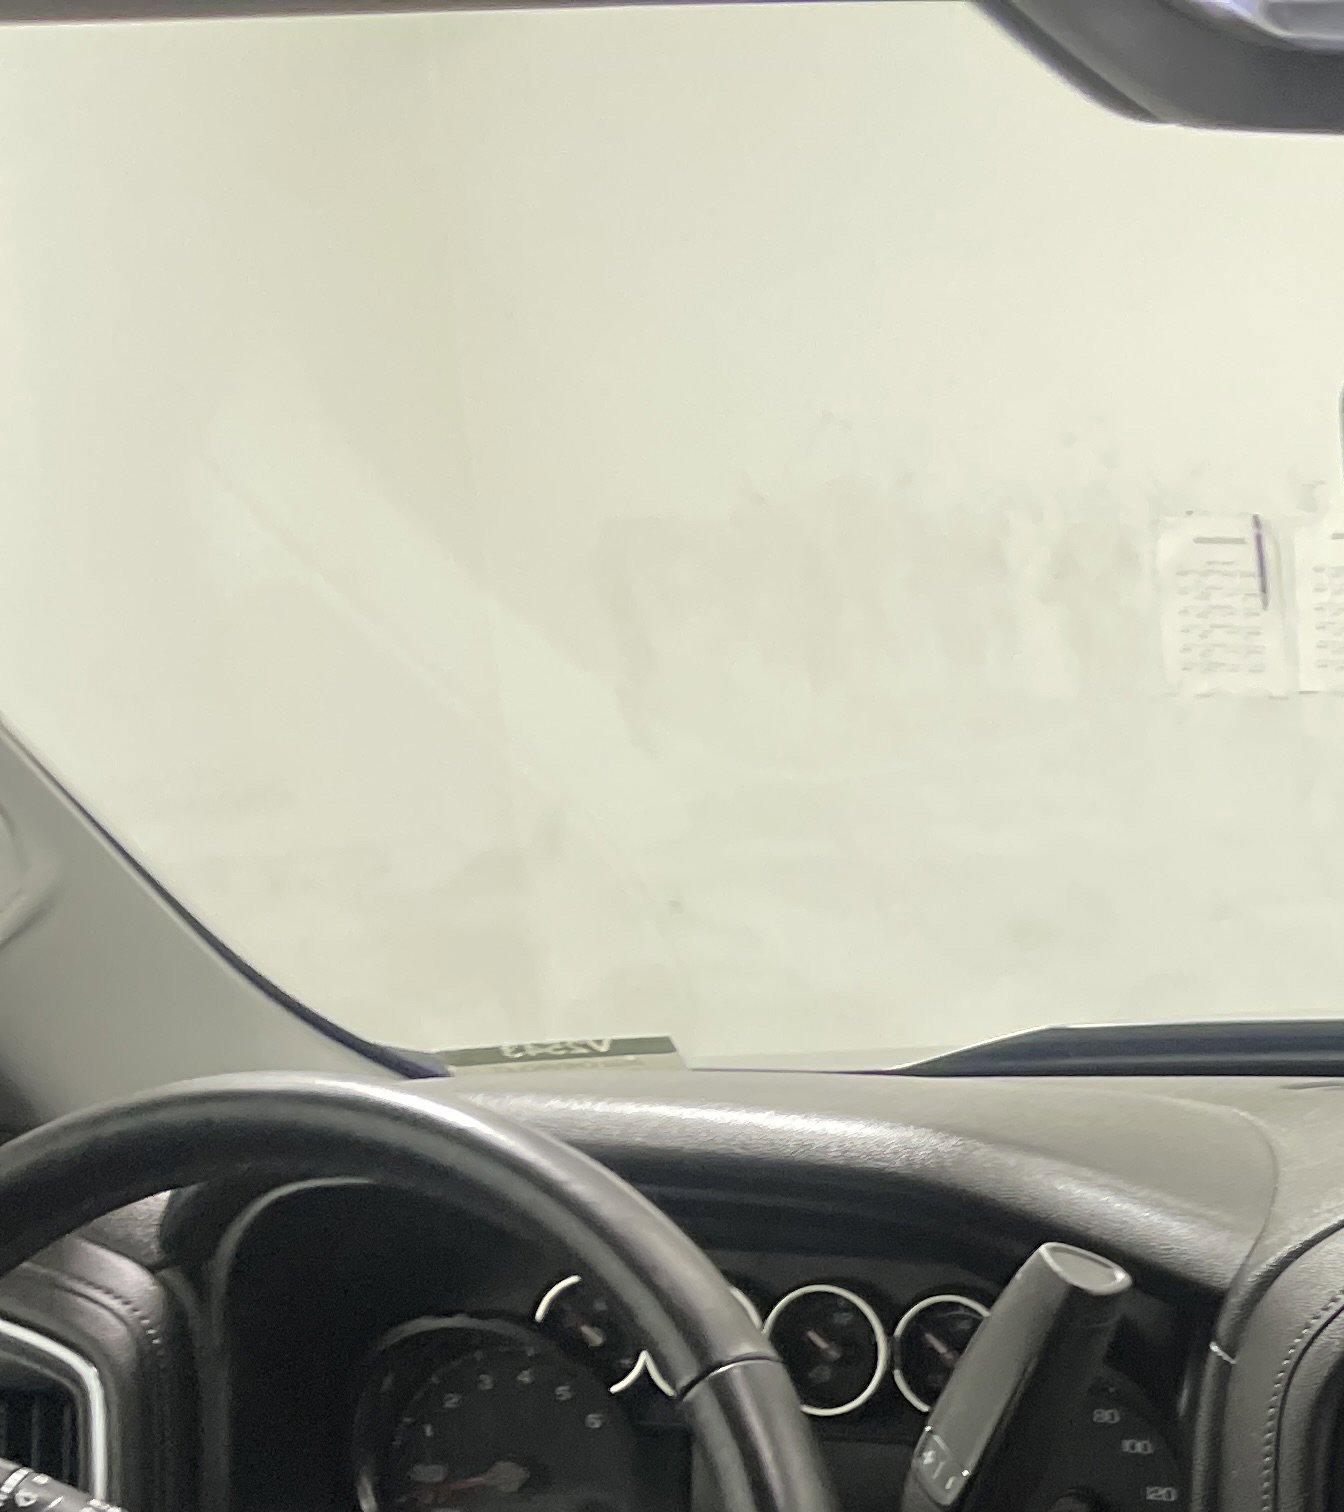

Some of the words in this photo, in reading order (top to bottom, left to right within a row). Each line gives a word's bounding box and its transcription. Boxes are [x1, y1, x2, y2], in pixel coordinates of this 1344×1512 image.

[478, 1374, 494, 1390] 3
[443, 1393, 461, 1408] 2
[555, 1385, 572, 1401] 5
[585, 1413, 605, 1429] 6
[1092, 1408, 1120, 1424] 80
[1121, 1439, 1154, 1454] 100
[1145, 1486, 1178, 1502] 120
